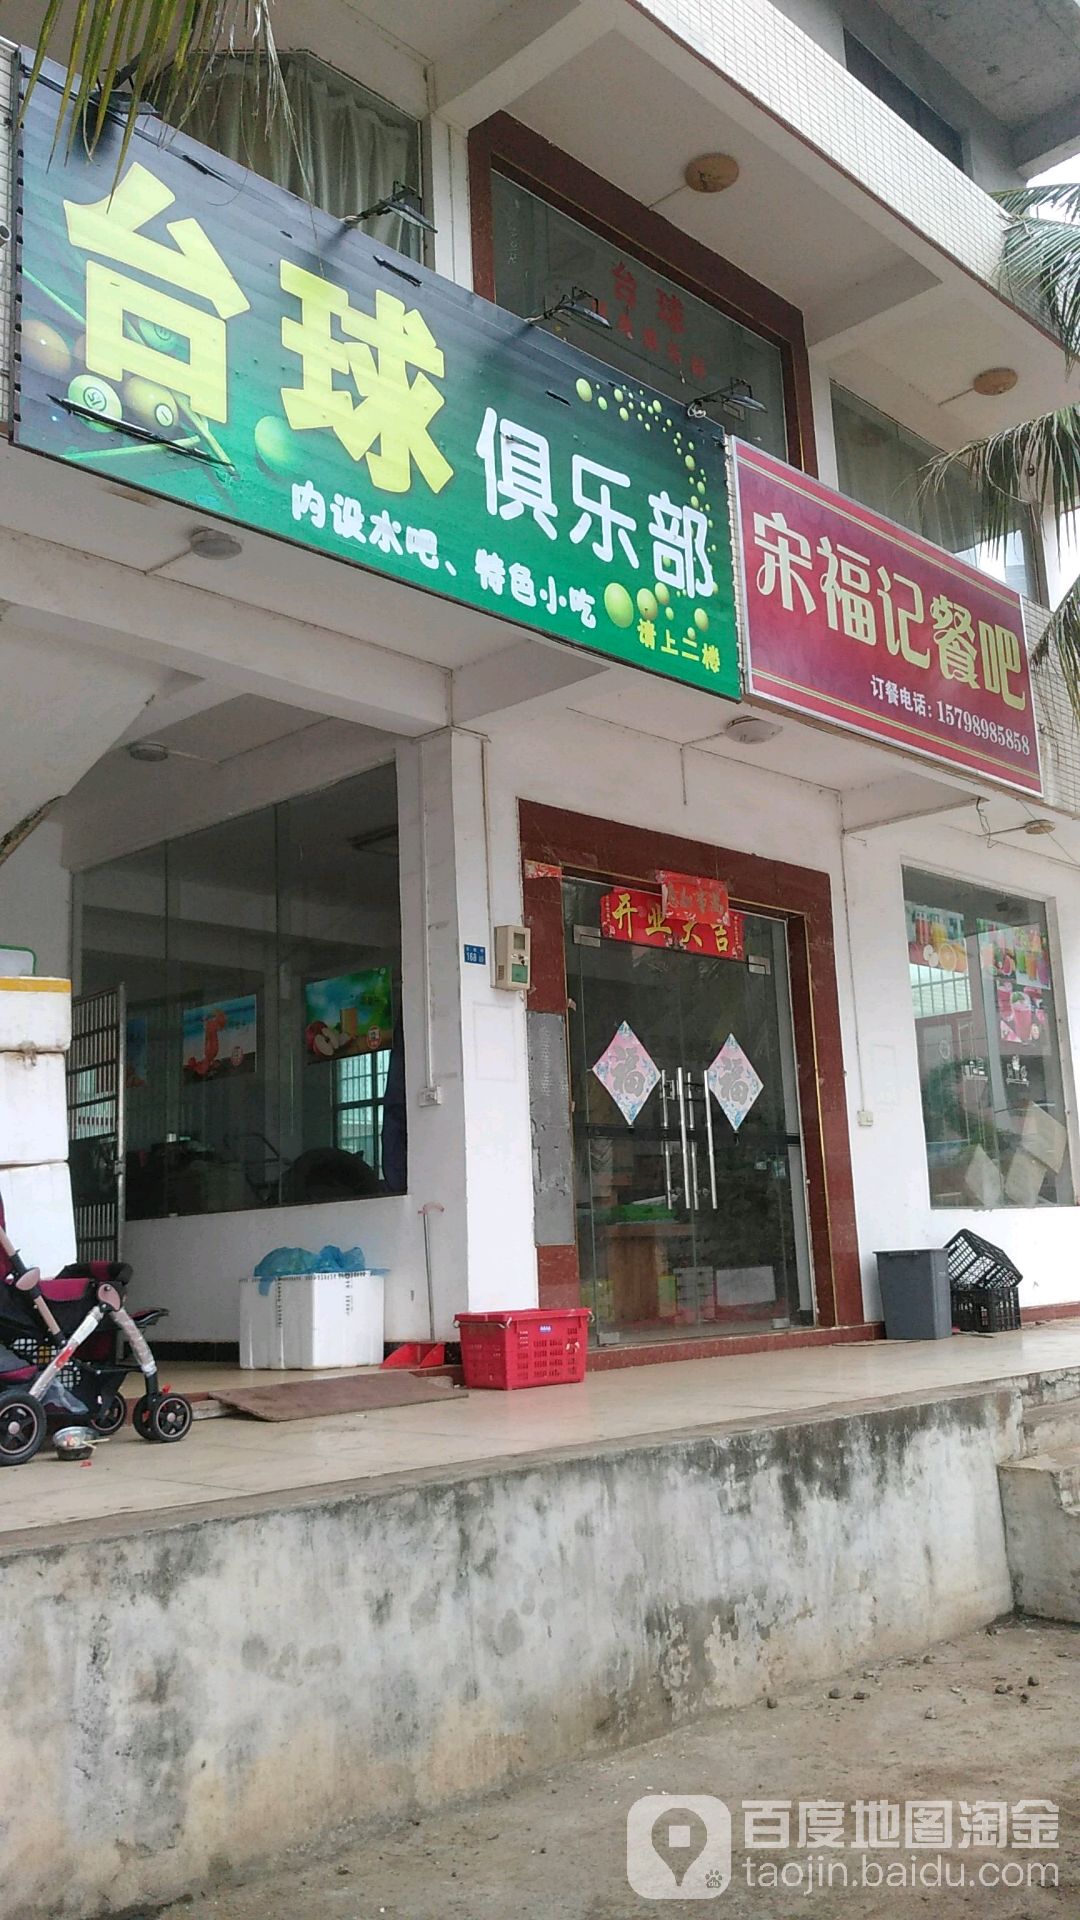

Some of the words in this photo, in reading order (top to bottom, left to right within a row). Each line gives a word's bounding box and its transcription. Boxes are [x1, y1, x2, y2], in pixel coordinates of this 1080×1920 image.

[63, 162, 454, 494] 台球
[475, 407, 714, 599] 俱乐部
[637, 618, 720, 673] 请上二楼
[753, 512, 1027, 711] 宋福记餐吧
[612, 893, 729, 953] 开业大吉
